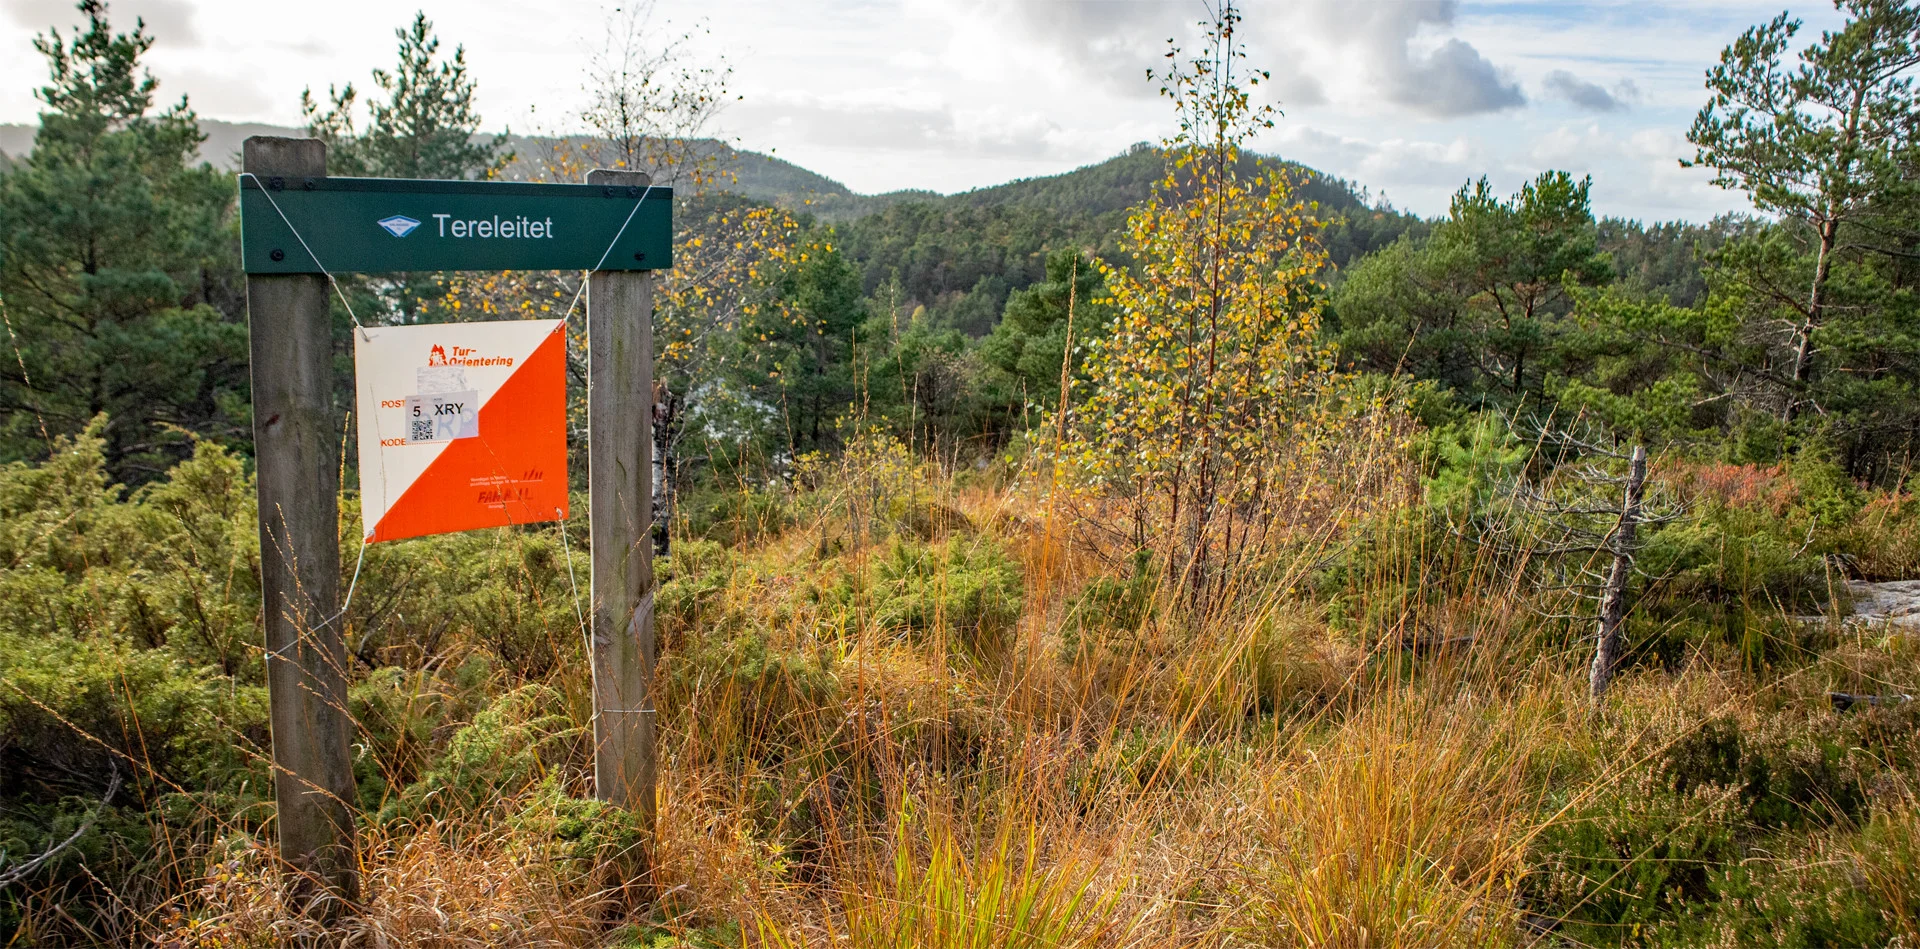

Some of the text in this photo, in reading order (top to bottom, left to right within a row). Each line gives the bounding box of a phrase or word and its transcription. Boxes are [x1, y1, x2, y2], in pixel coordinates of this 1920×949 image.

[432, 213, 553, 238] Tereleitet
[452, 346, 477, 357] Tur-
[449, 355, 514, 367] Orientering
[381, 399, 406, 409] POST
[412, 402, 464, 418] 5 XRY
[380, 437, 406, 447] KODE
